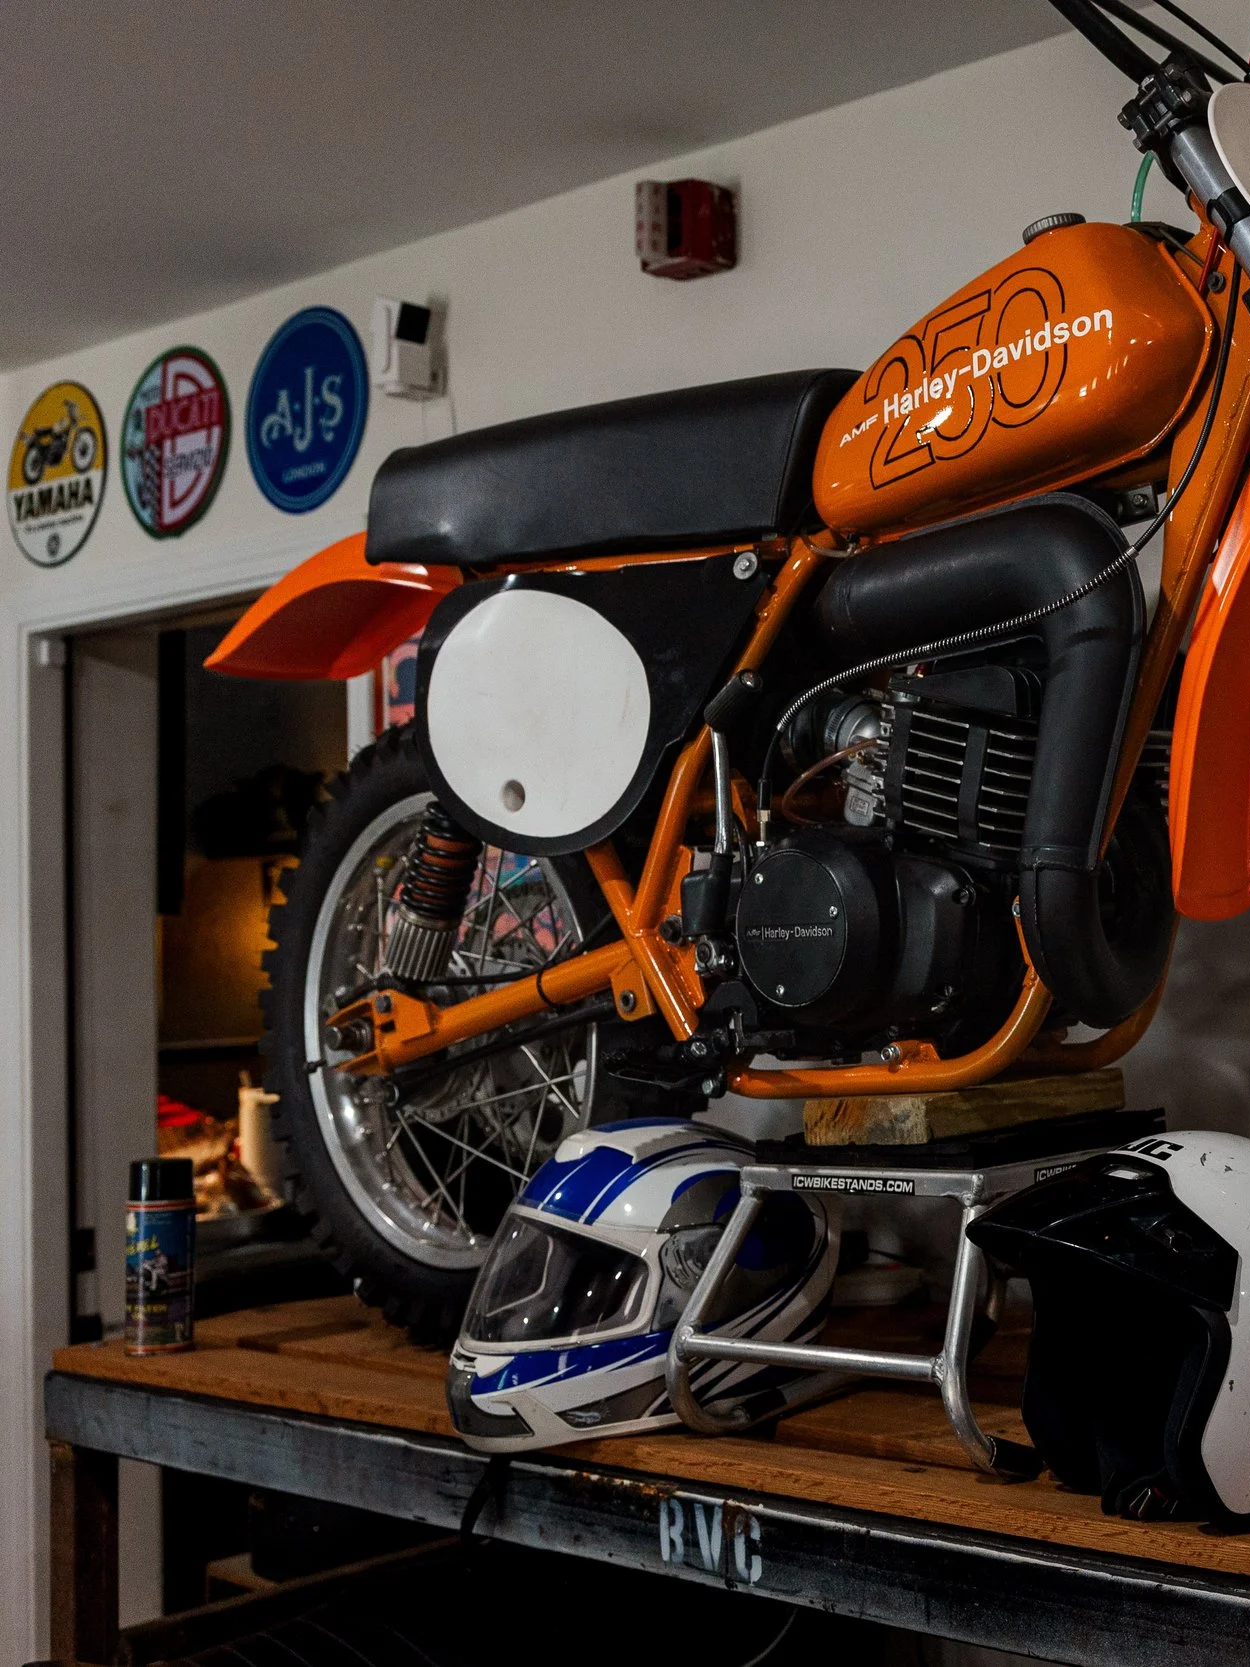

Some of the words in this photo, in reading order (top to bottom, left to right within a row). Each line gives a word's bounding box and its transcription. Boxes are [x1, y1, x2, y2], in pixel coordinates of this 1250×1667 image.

[840, 414, 879, 447] AMF
[883, 309, 1112, 424] Harley-Davidson
[865, 267, 1067, 490] 250
[149, 391, 220, 441] DUCATI
[13, 476, 94, 522] YAMAHA
[765, 925, 832, 940] Harley-Davidson
[1113, 1139, 1184, 1161] JC
[793, 1176, 914, 1194] ICWBIKESTANDS.COM
